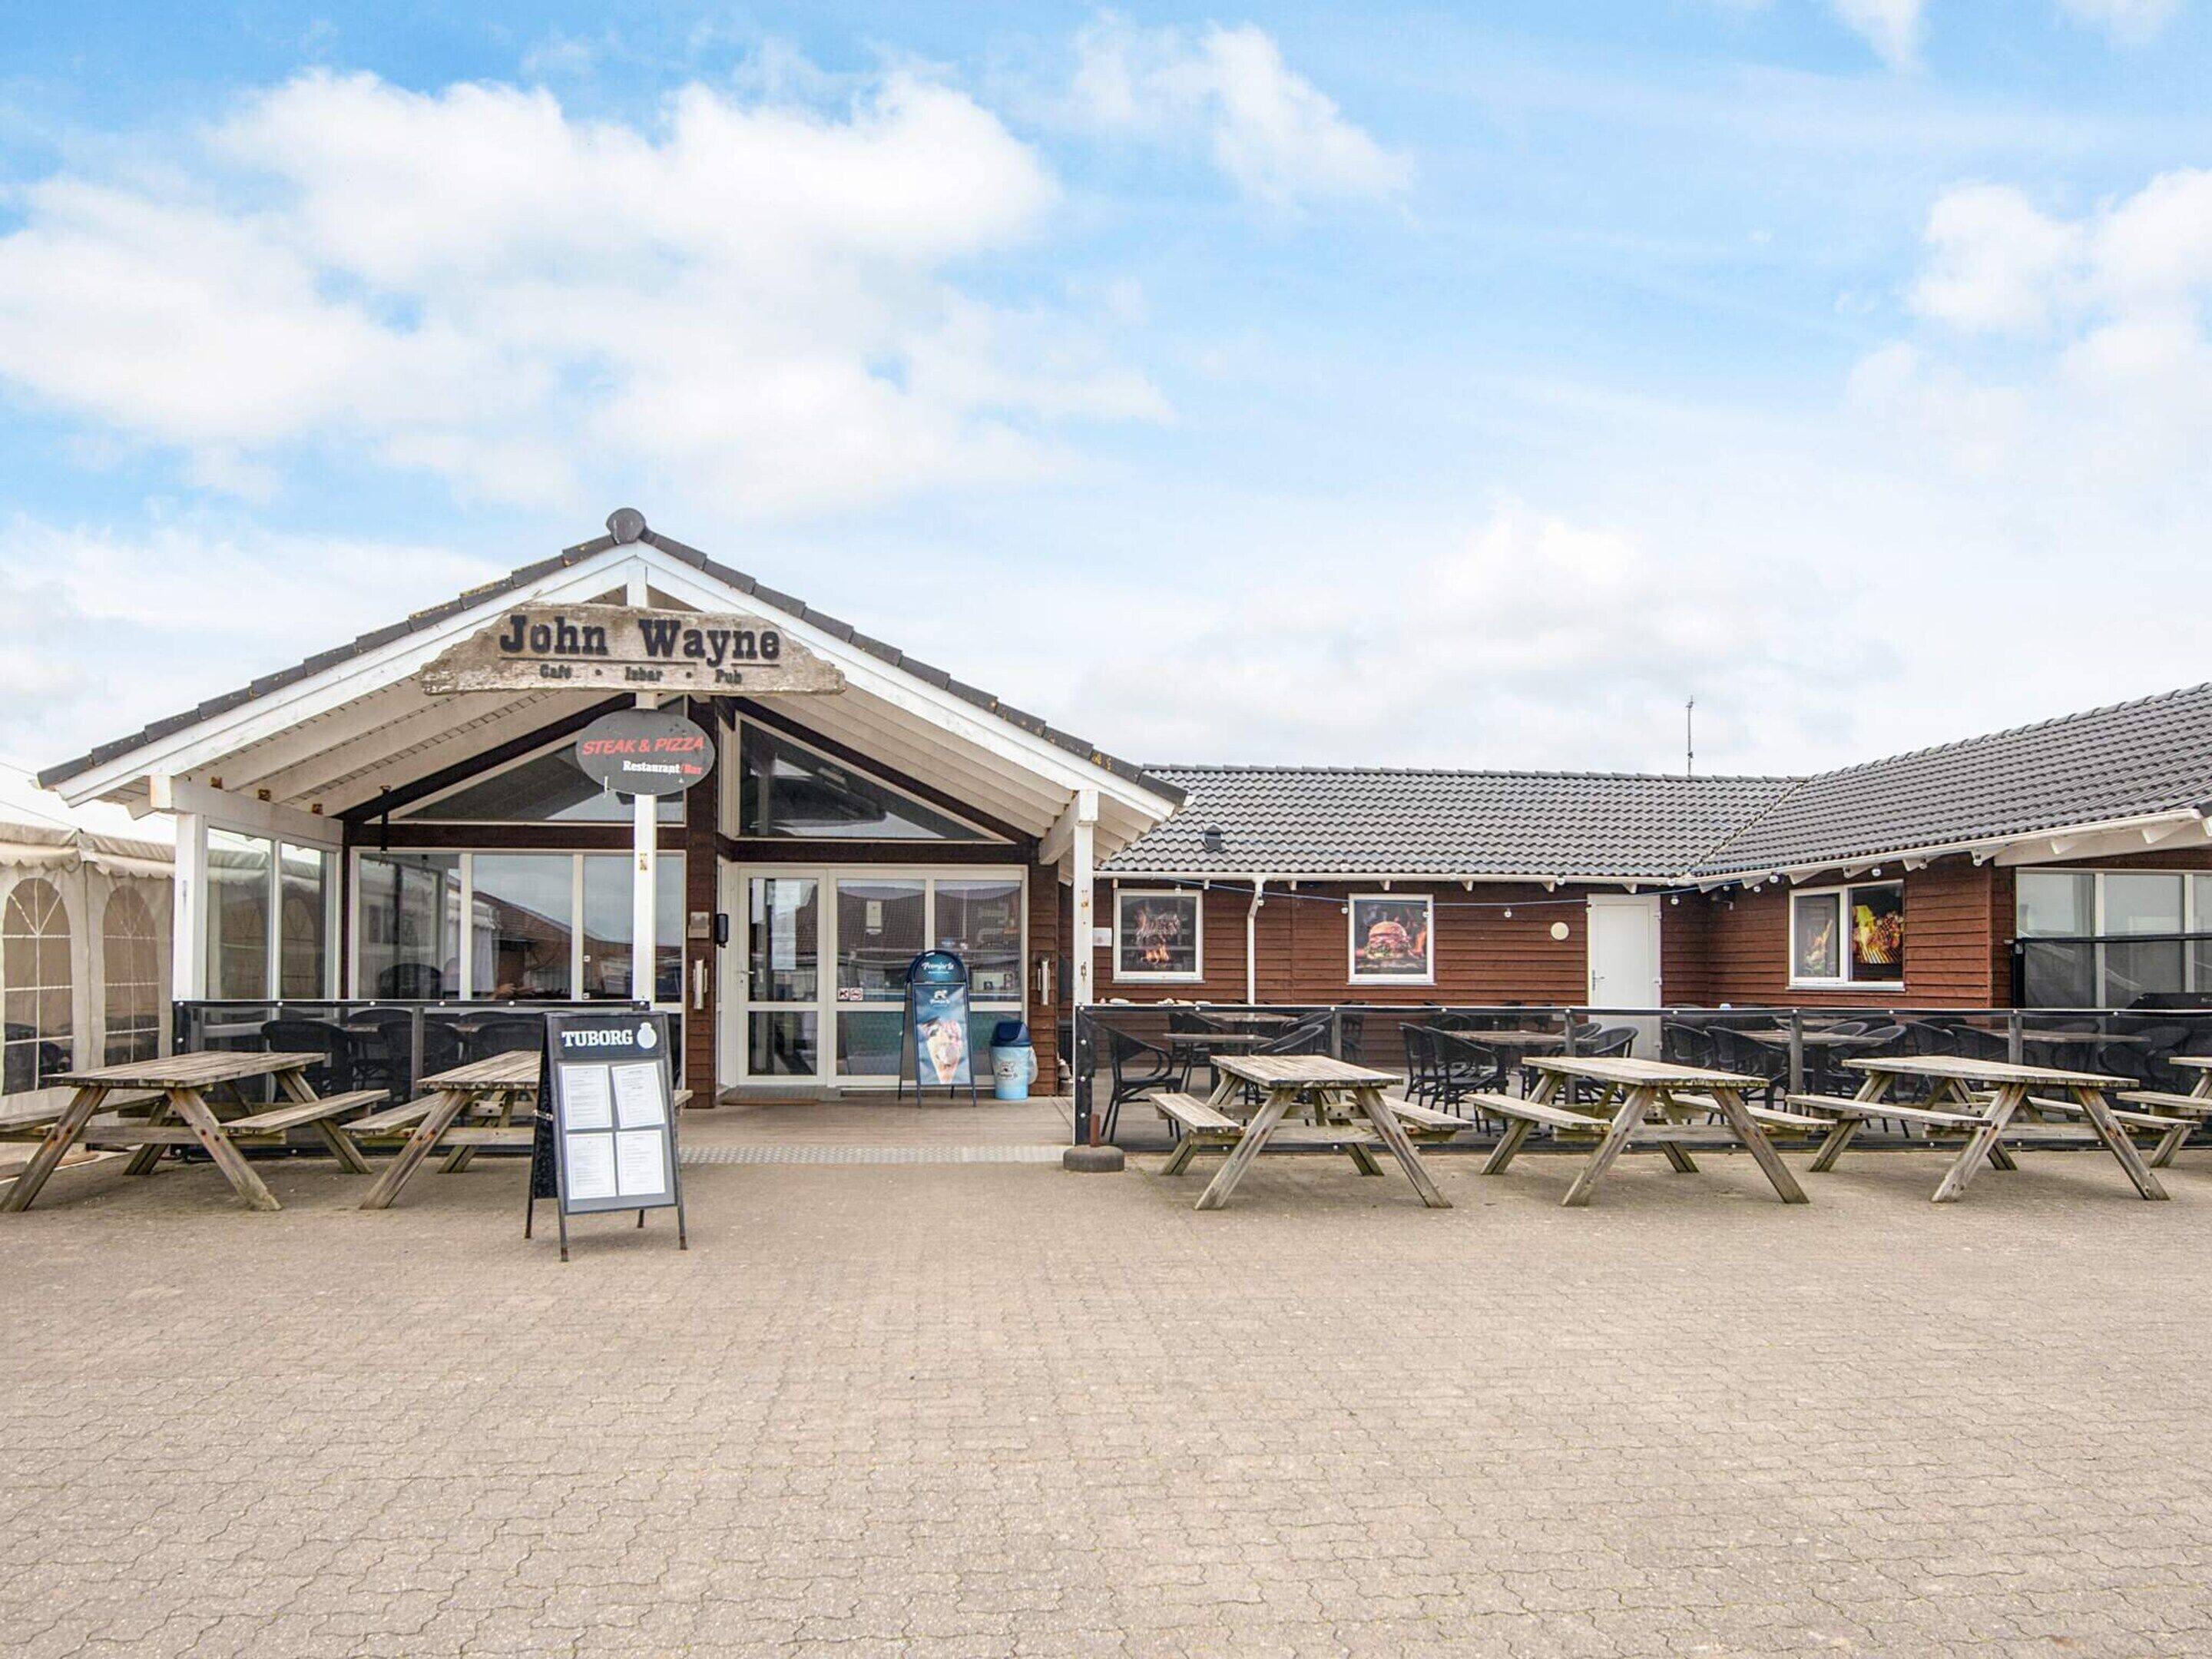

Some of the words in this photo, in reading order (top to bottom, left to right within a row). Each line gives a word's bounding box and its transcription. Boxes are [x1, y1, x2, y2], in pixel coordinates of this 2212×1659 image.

[500, 614, 608, 655] John
[637, 618, 780, 667] Wayne
[715, 669, 743, 684] Pub
[581, 739, 637, 756] STEAK
[638, 739, 650, 753] &
[654, 737, 704, 753] PIZZA
[623, 760, 680, 774] Restaurant
[561, 1029, 634, 1047] TUBORG
